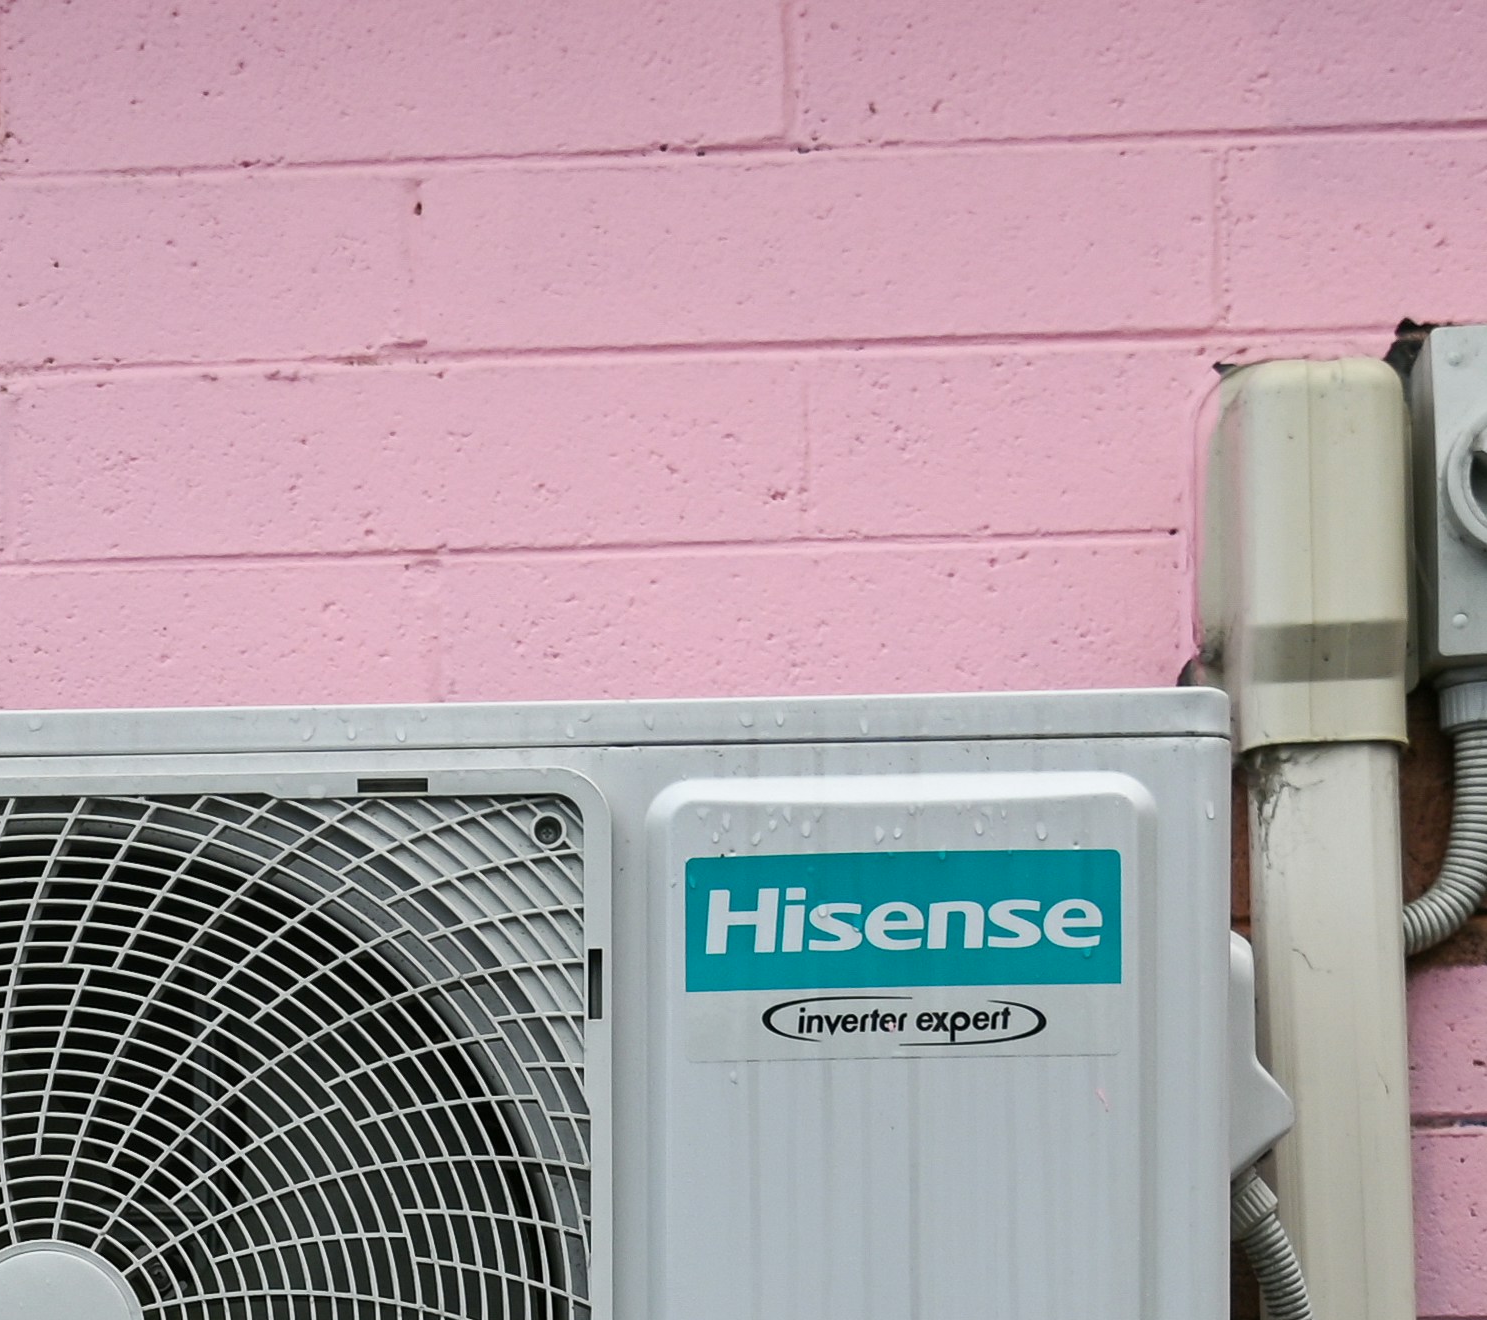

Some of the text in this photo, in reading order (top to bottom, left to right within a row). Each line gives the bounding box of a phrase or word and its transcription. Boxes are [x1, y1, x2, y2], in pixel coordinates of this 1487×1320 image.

[705, 887, 1103, 954] Hisense
[797, 1006, 1011, 1042] inverter expert
